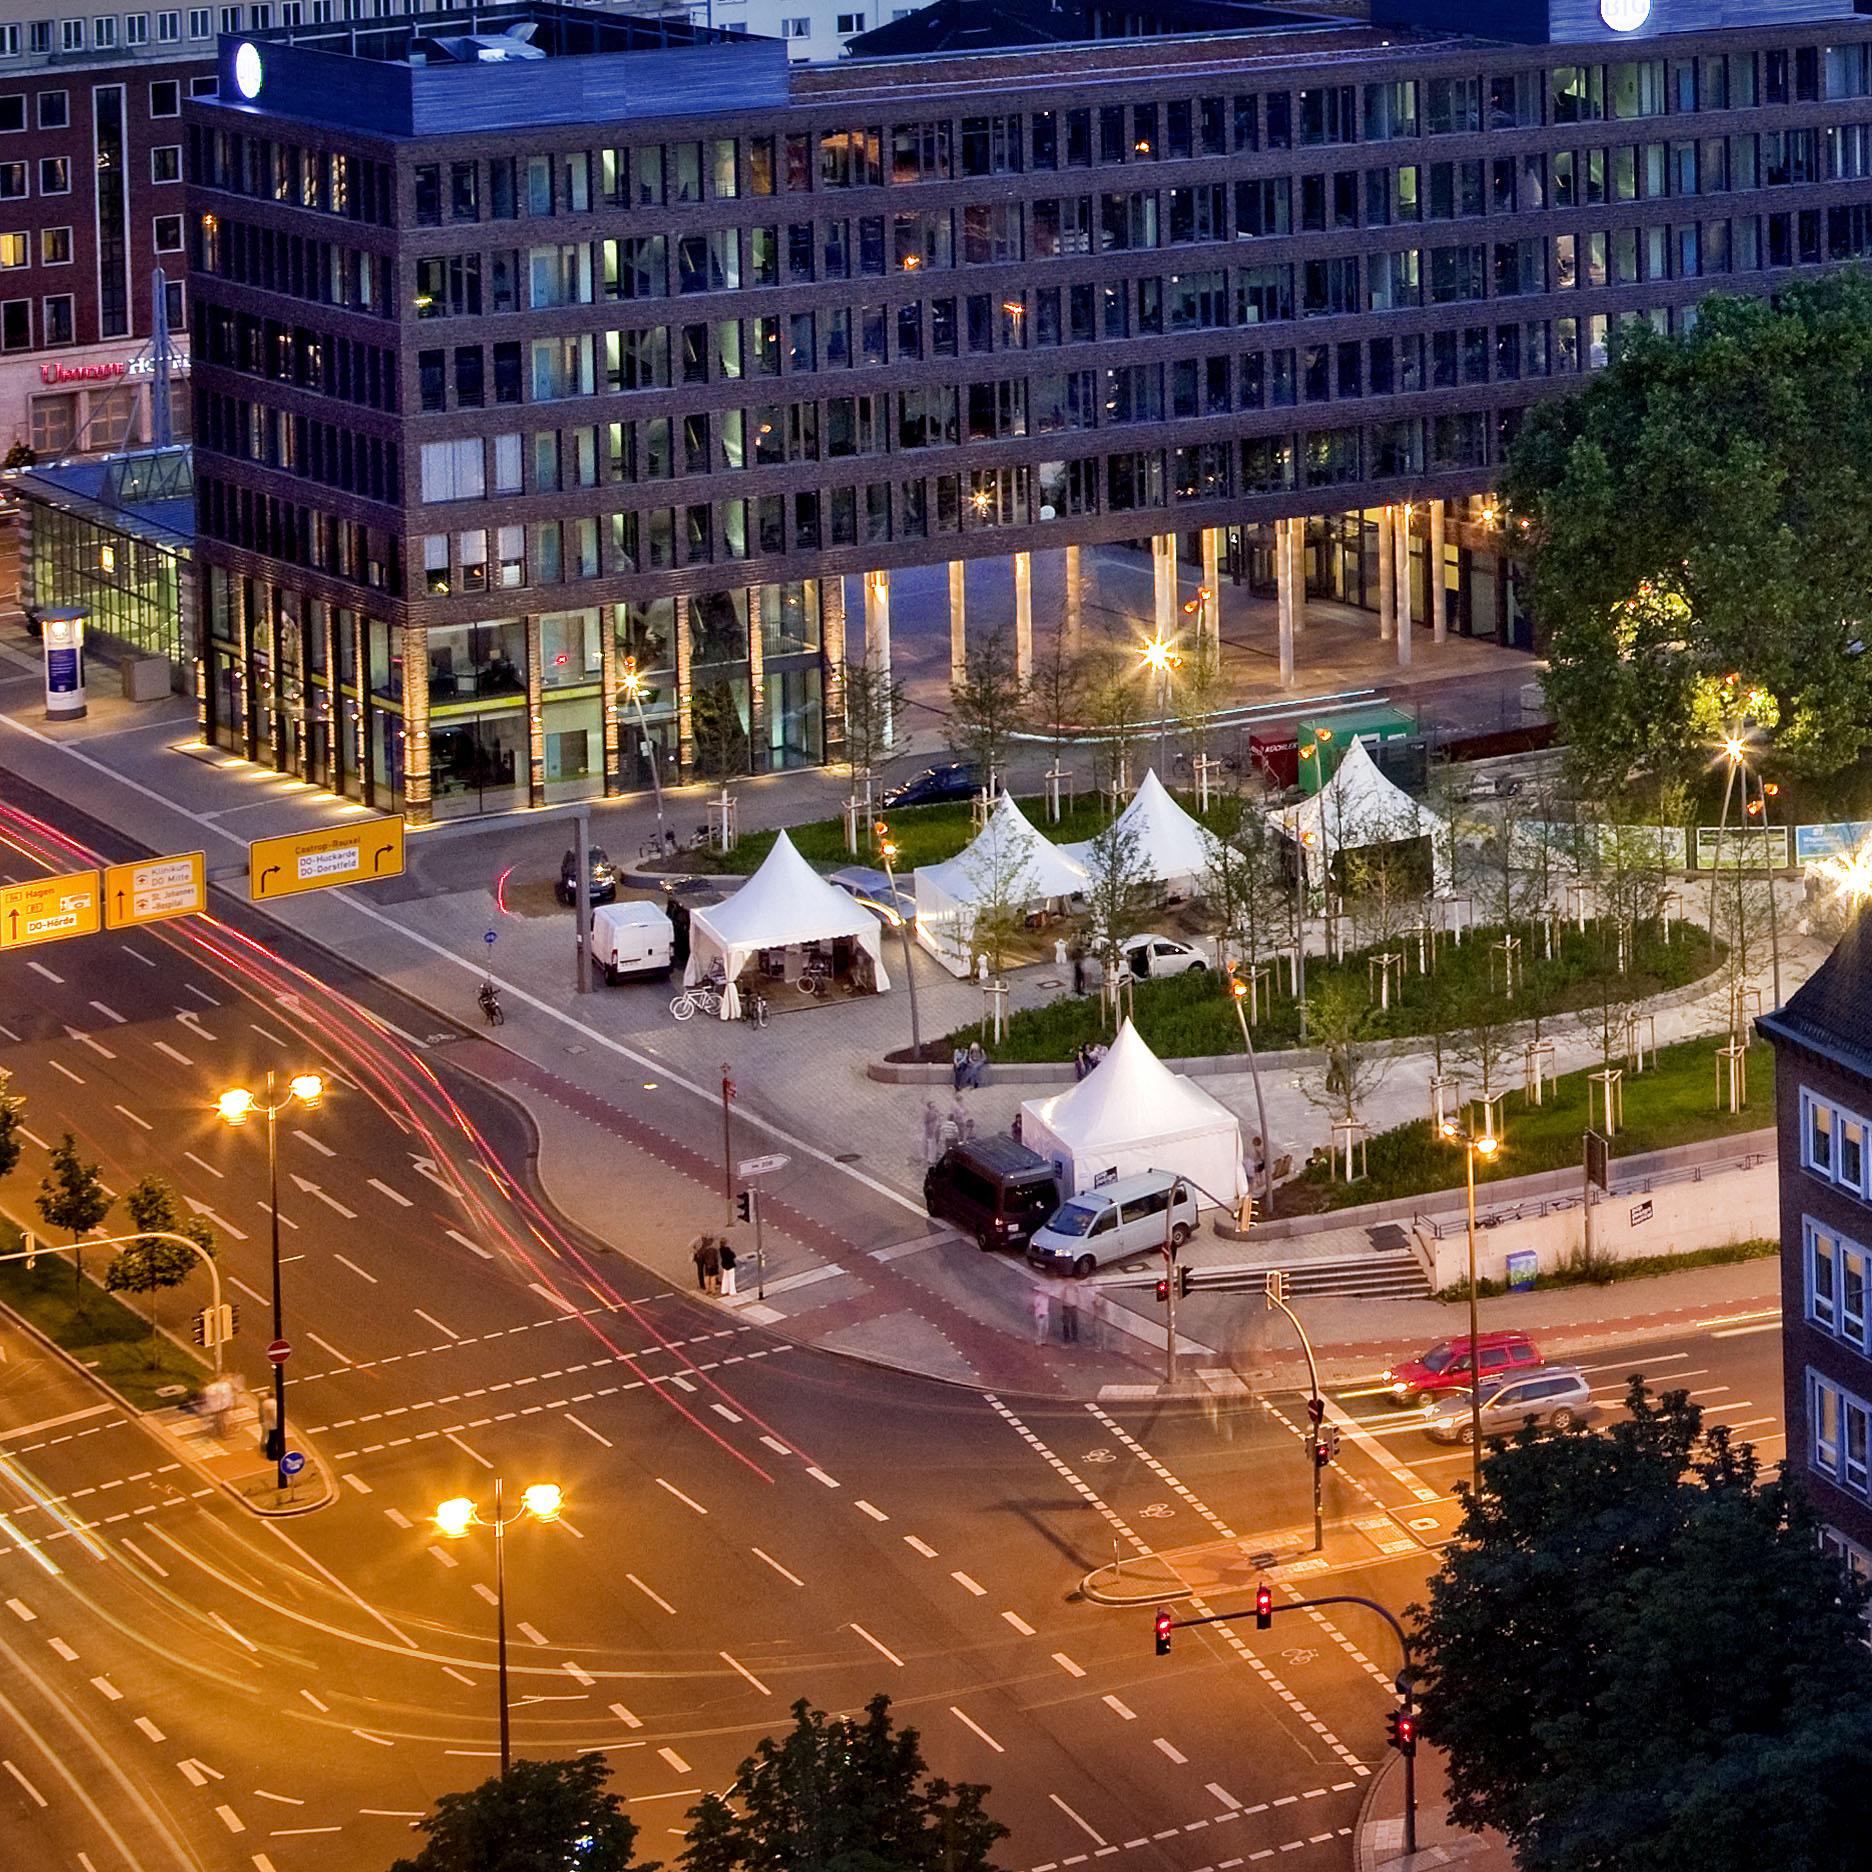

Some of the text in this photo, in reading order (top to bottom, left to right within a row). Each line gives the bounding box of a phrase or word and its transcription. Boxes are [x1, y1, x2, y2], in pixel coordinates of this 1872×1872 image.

[300, 850, 356, 866] DO-Huckarde
[301, 860, 357, 876] DO-Dorstfeld
[26, 888, 55, 898] Hagen
[29, 917, 74, 931] DO-Hörde
